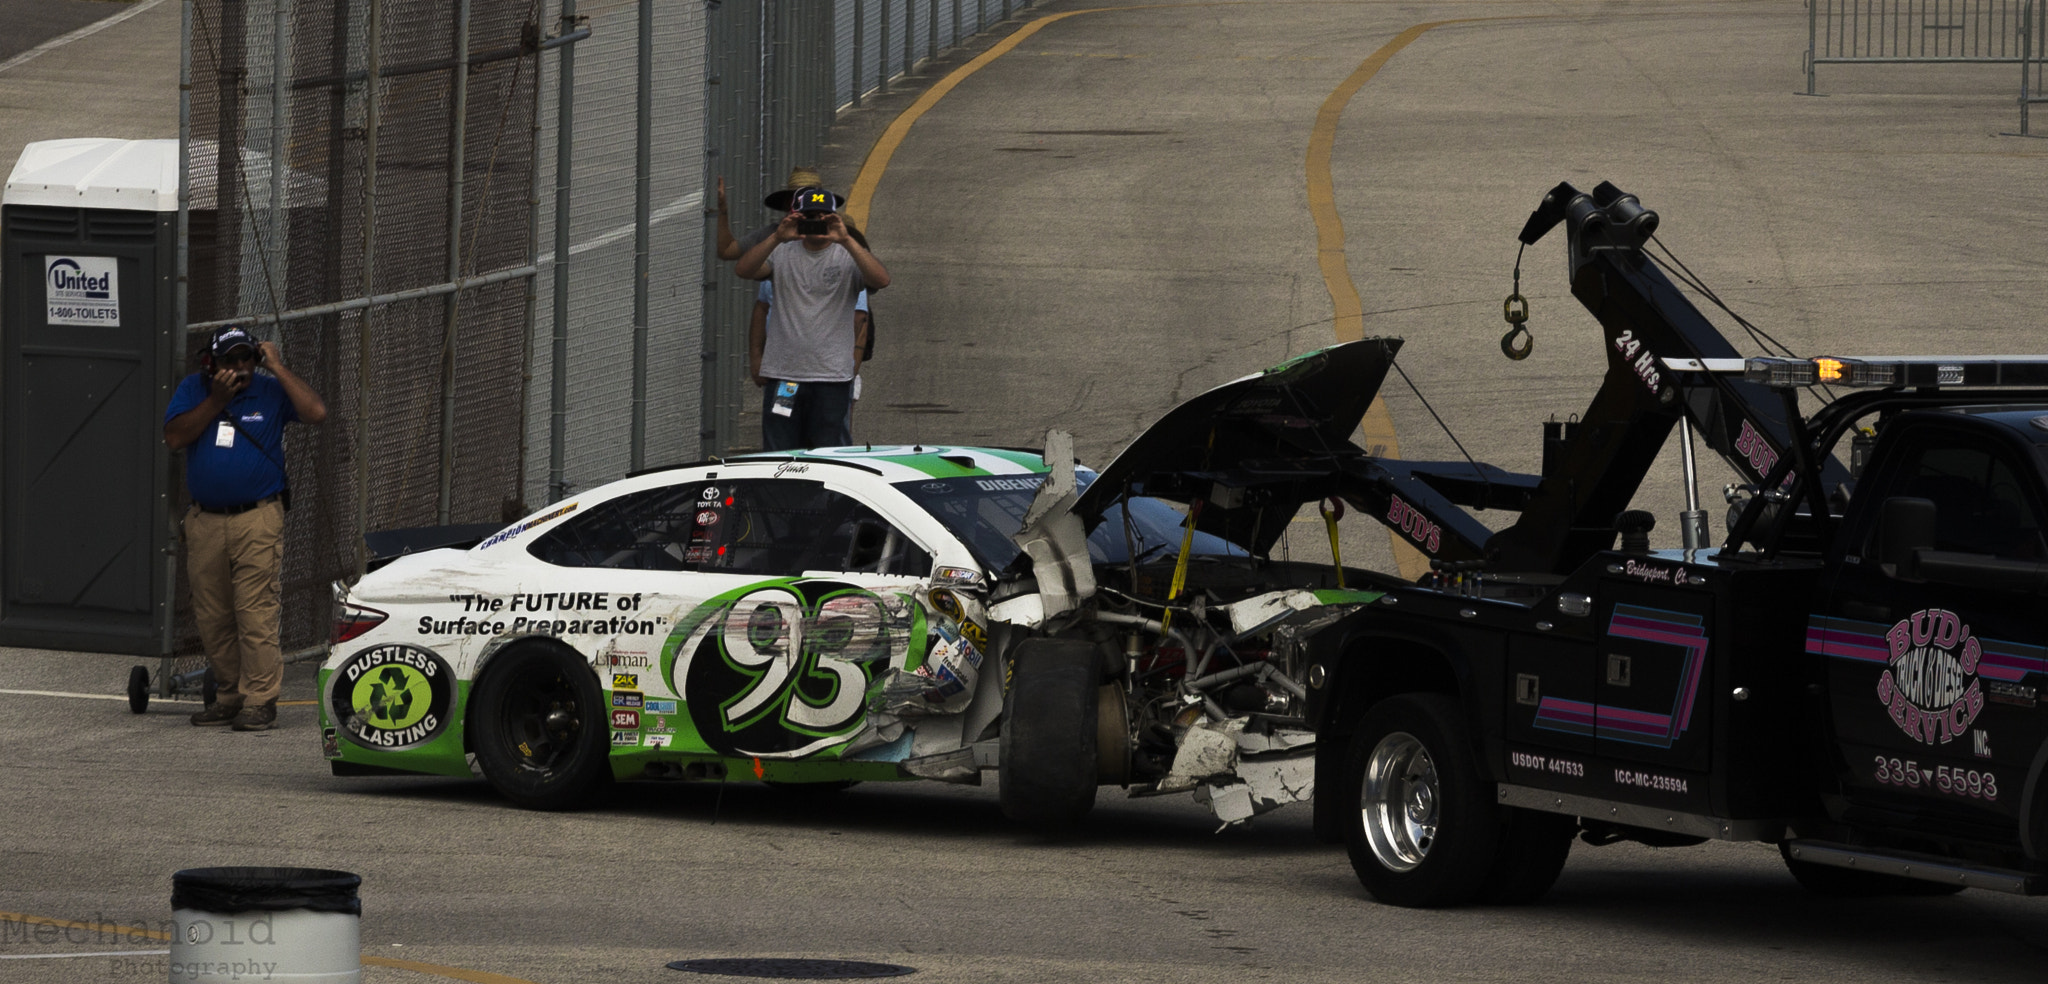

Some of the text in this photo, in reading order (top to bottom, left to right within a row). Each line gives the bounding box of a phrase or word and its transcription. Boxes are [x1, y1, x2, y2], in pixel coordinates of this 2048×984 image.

[812, 193, 825, 203] M
[54, 269, 109, 291] United
[49, 307, 118, 319] 1-800-TOILETS
[1615, 329, 1660, 394] 24 Hrs.
[1387, 493, 1441, 553] BUD'S
[511, 593, 608, 611] FUTURE
[617, 593, 642, 610] of
[418, 616, 505, 635] Surface
[1886, 608, 1982, 676] BUD'S
[346, 646, 438, 682] DUSTLESS
[595, 649, 648, 675] Lipman
[720, 586, 884, 734] 93
[614, 674, 636, 685] ZAK
[1897, 647, 1964, 708] TRUCK & DIESEL
[1877, 669, 1984, 745] SERVICE
[615, 714, 636, 726] SEM
[1974, 729, 1991, 757] INC.
[1512, 752, 1584, 777] USDOT 447533
[1614, 769, 1688, 794] ICC-MC-235594
